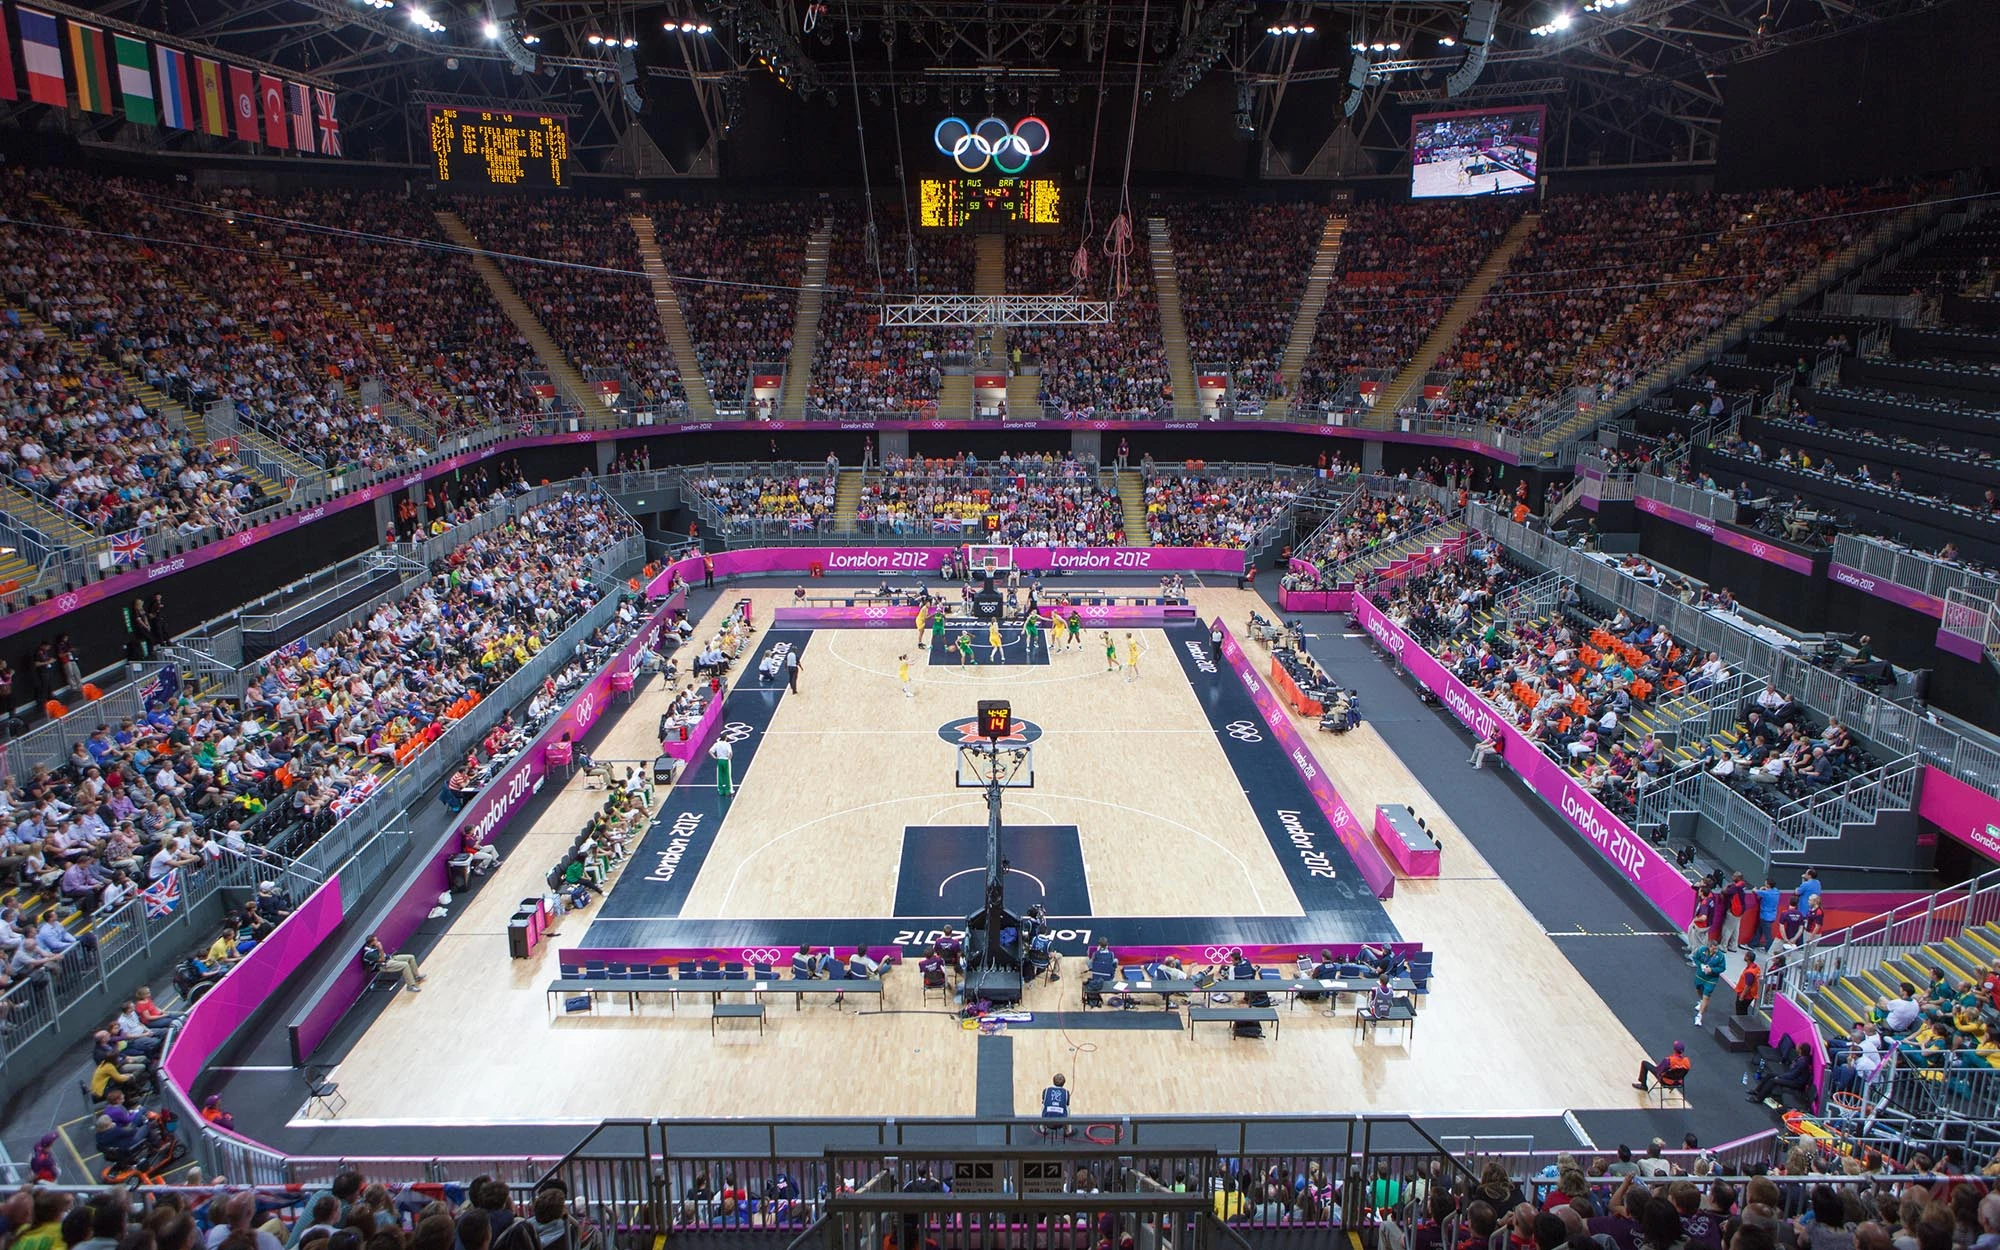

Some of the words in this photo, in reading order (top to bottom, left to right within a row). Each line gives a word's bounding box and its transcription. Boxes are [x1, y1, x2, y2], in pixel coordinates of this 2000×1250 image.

[444, 110, 457, 118] AUS
[479, 126, 500, 134] FIELD
[504, 128, 525, 136] GOALS
[481, 147, 497, 155] FREE
[503, 149, 527, 157] THROWS
[486, 155, 519, 163] REBOUNDS
[487, 168, 524, 177] TURNOVERS
[970, 202, 980, 210] 59
[1004, 202, 1014, 210] 49
[988, 520, 997, 529] 14
[1695, 520, 1711, 532] London
[829, 551, 887, 567] London
[892, 552, 928, 567] 2012
[1051, 551, 1109, 567] London
[1114, 552, 1150, 566] 2012
[148, 563, 170, 578] London
[171, 558, 184, 571] 2012
[1837, 570, 1859, 586] London
[1860, 578, 1875, 591] 2012
[1368, 610, 1389, 645] London
[1185, 640, 1208, 659] London
[1242, 669, 1254, 686] London
[1445, 680, 1475, 724] London
[988, 709, 1008, 718] 4:42
[991, 718, 1004, 730] 14
[1293, 747, 1307, 770] London
[1304, 763, 1316, 781] 2012
[473, 795, 507, 840] ondon
[509, 764, 531, 804] 2012
[1561, 784, 1608, 848] London
[1610, 828, 1645, 880] 2012
[644, 838, 690, 882] London
[669, 812, 704, 837] 2012
[1277, 810, 1315, 848] London
[1300, 851, 1336, 878] 2012
